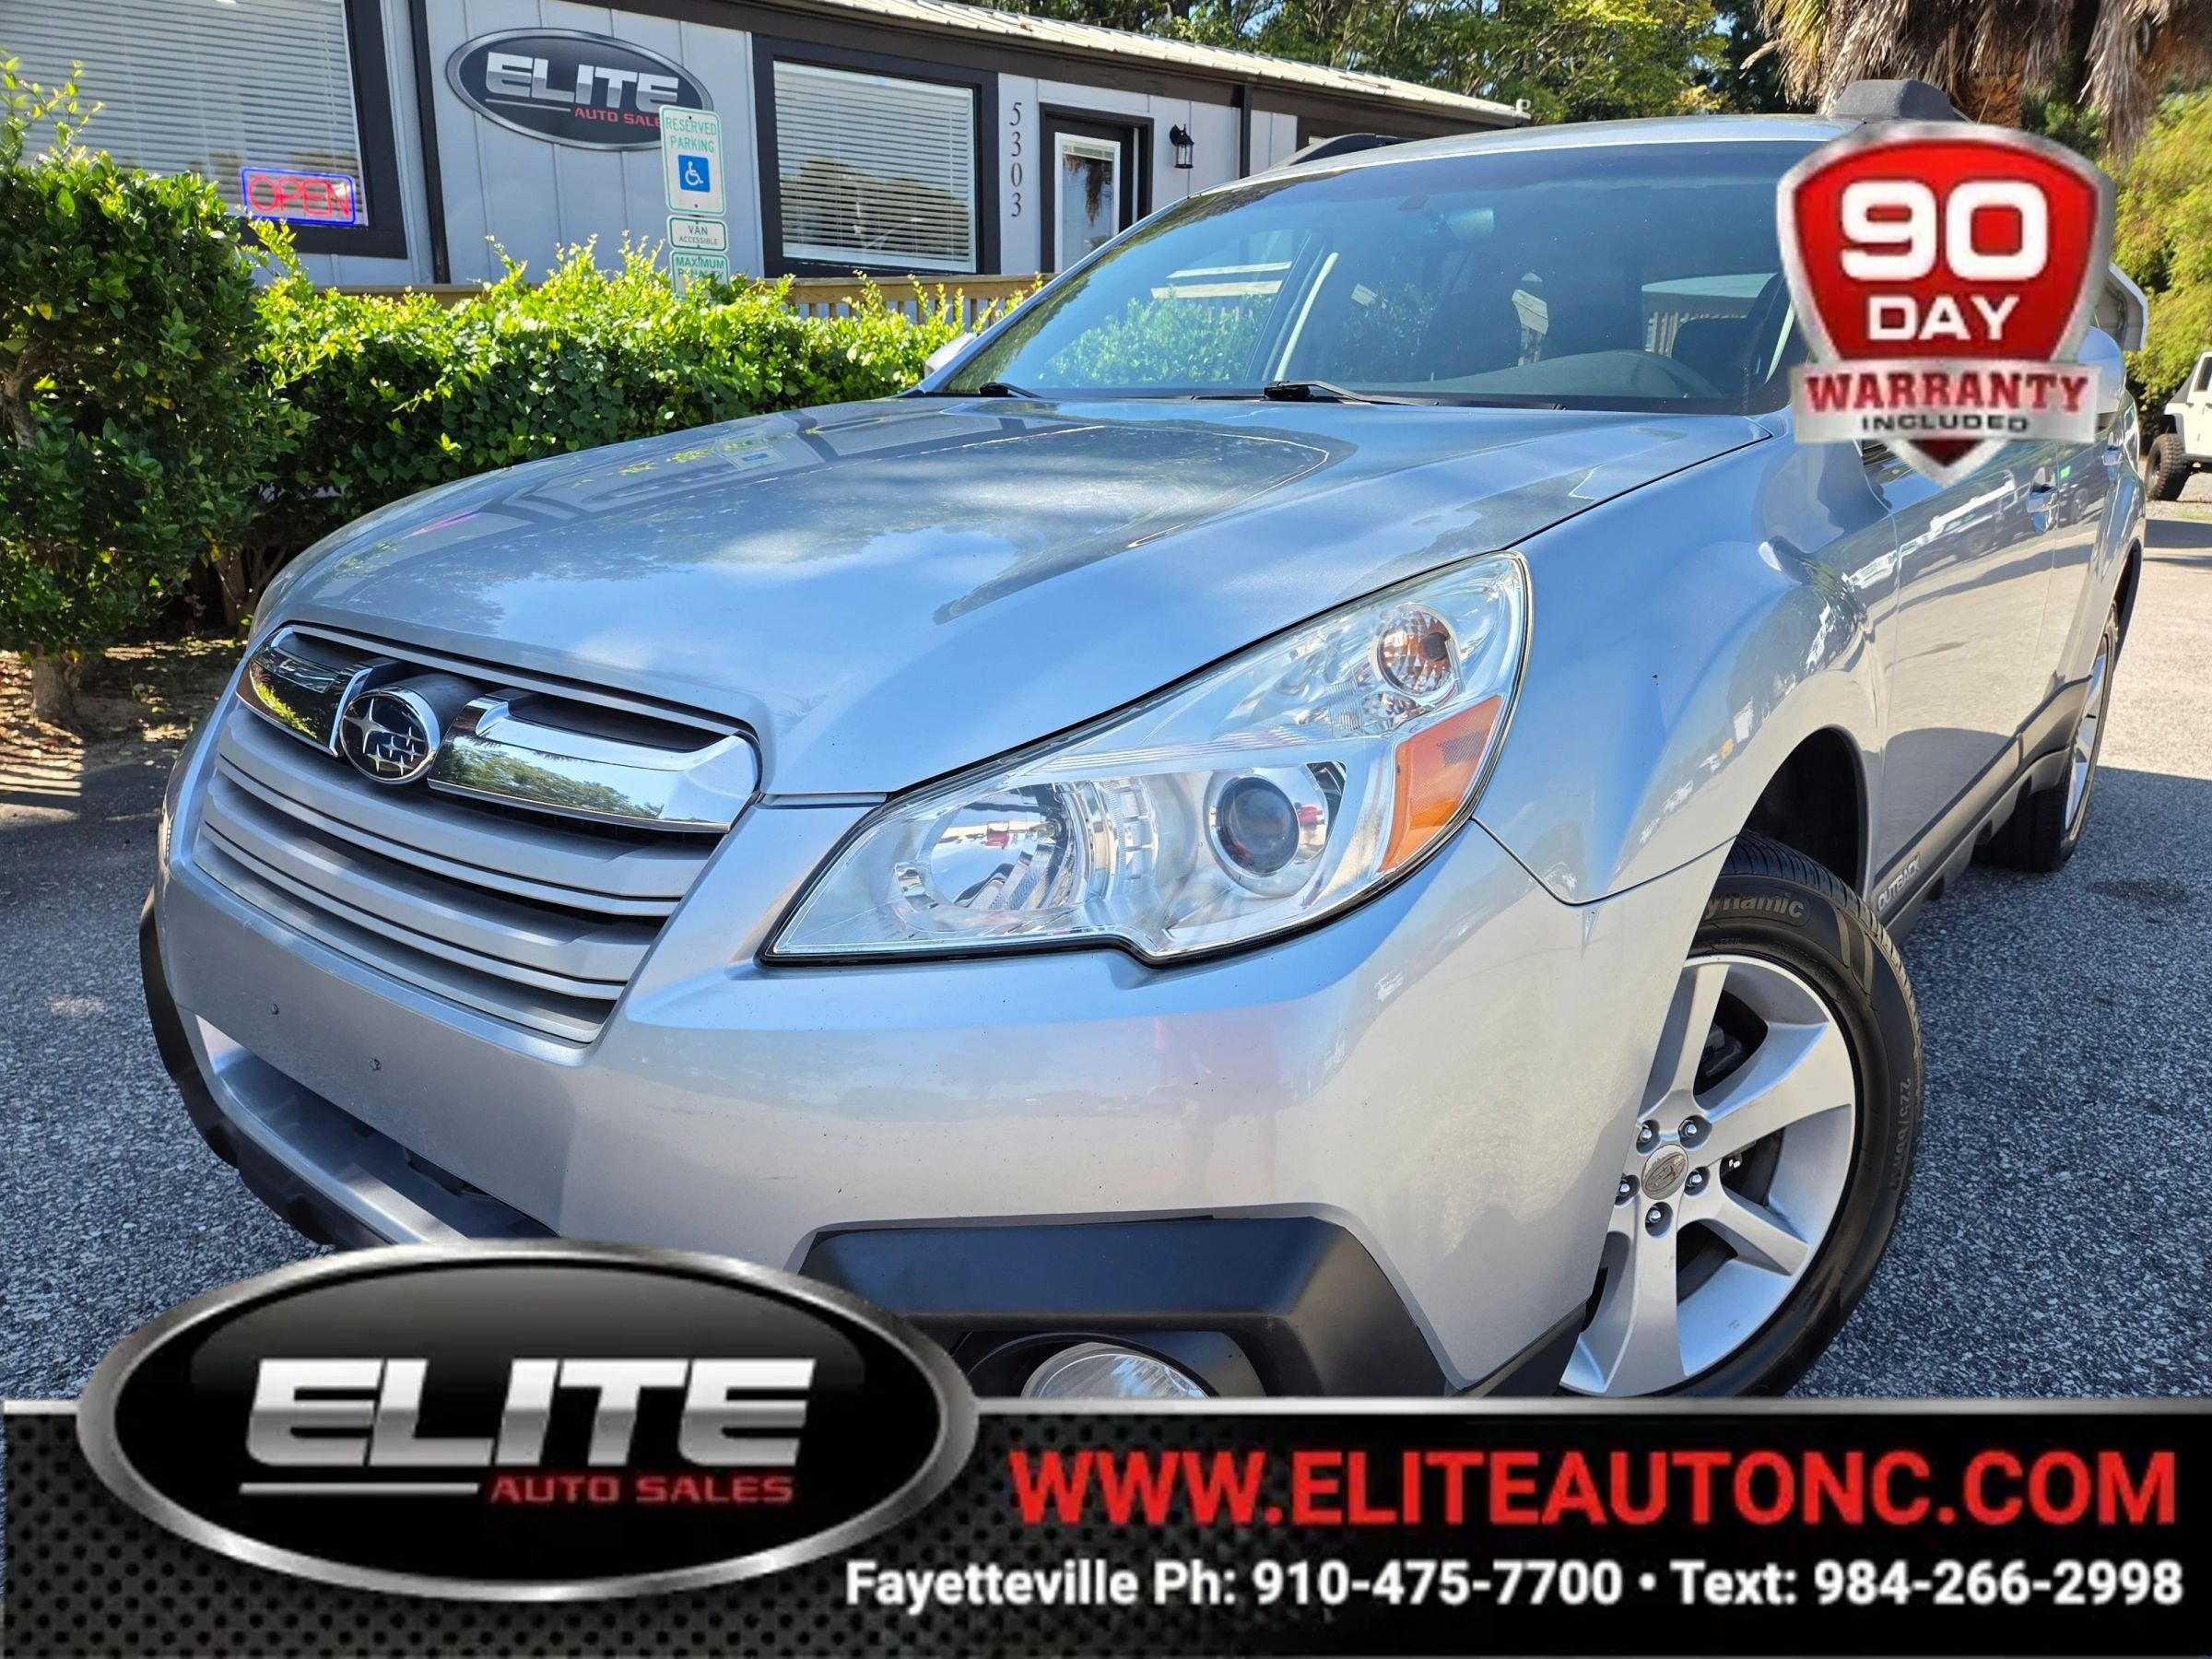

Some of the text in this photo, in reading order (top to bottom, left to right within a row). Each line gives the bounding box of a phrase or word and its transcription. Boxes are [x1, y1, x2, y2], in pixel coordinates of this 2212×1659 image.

[486, 52, 679, 112] ELITE
[575, 107, 661, 127] AUTO SALE
[665, 117, 717, 135] RESERVED
[670, 135, 714, 153] PARKING
[1009, 101, 1022, 218] 5303
[248, 174, 349, 217] OPEN
[688, 225, 708, 236] VAN
[678, 235, 718, 245] ACCESSIBLE
[676, 256, 724, 269] MAXIMUM
[677, 268, 724, 280] PNAY
[1703, 892, 1806, 919] ynamic
